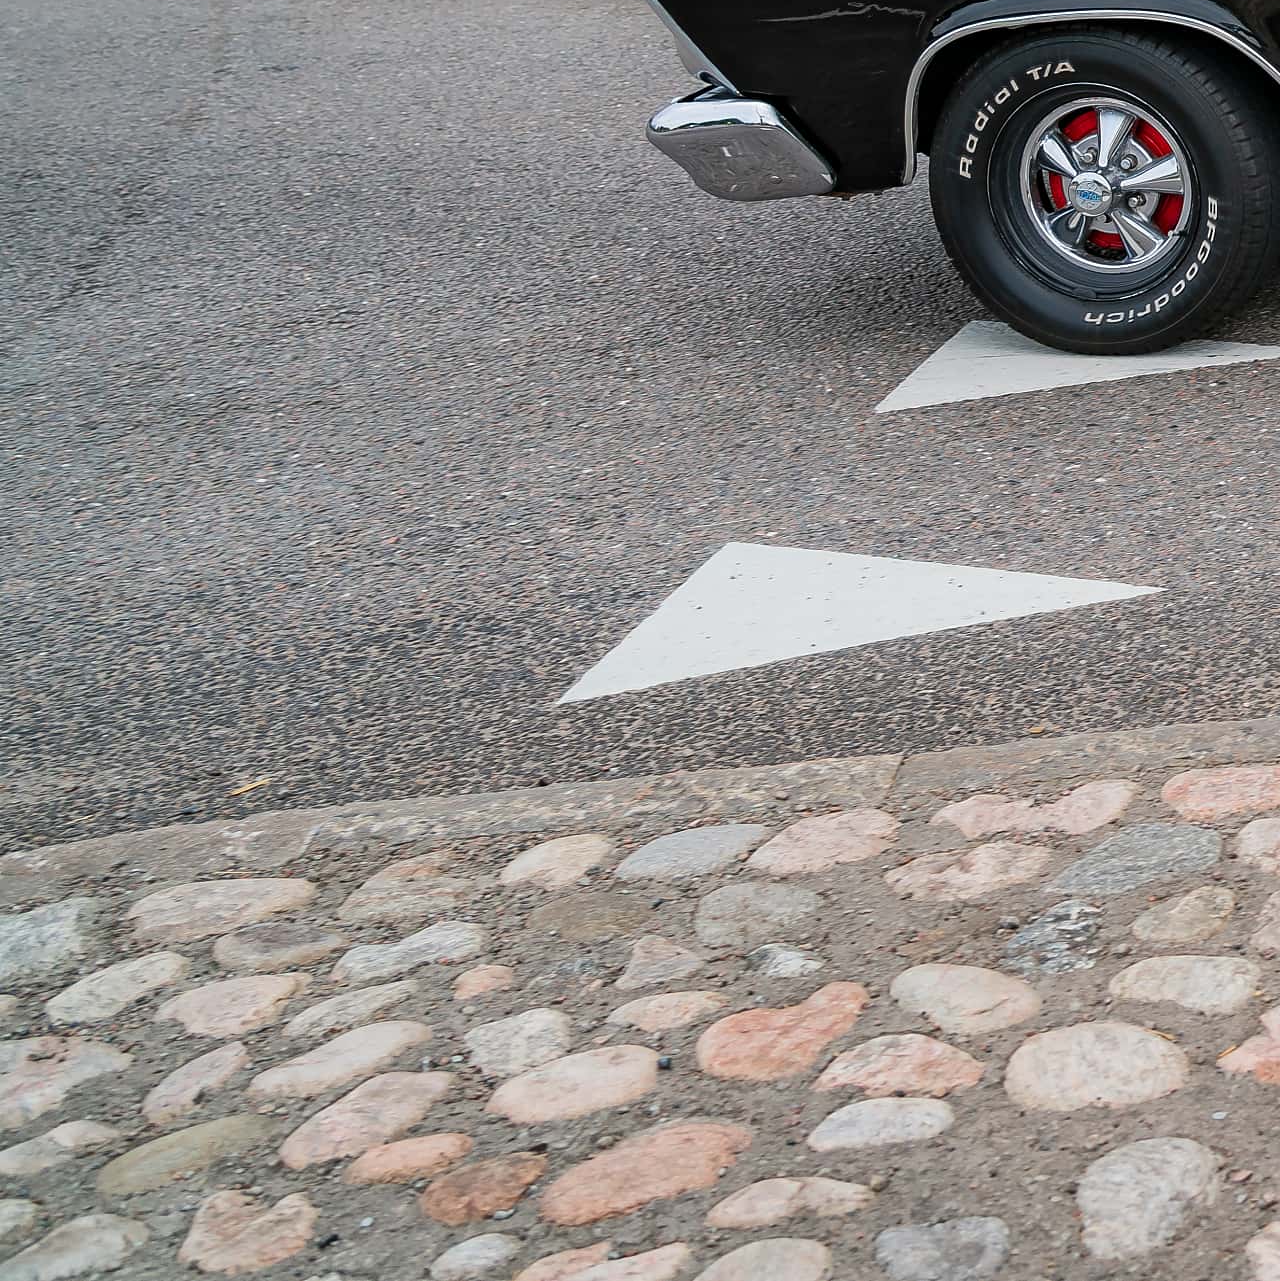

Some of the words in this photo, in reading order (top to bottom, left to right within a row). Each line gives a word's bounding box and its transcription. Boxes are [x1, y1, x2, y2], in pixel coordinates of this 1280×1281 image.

[959, 79, 1021, 180] Radial
[1025, 60, 1077, 82] T/A
[1083, 194, 1221, 327] BFGoodrich
